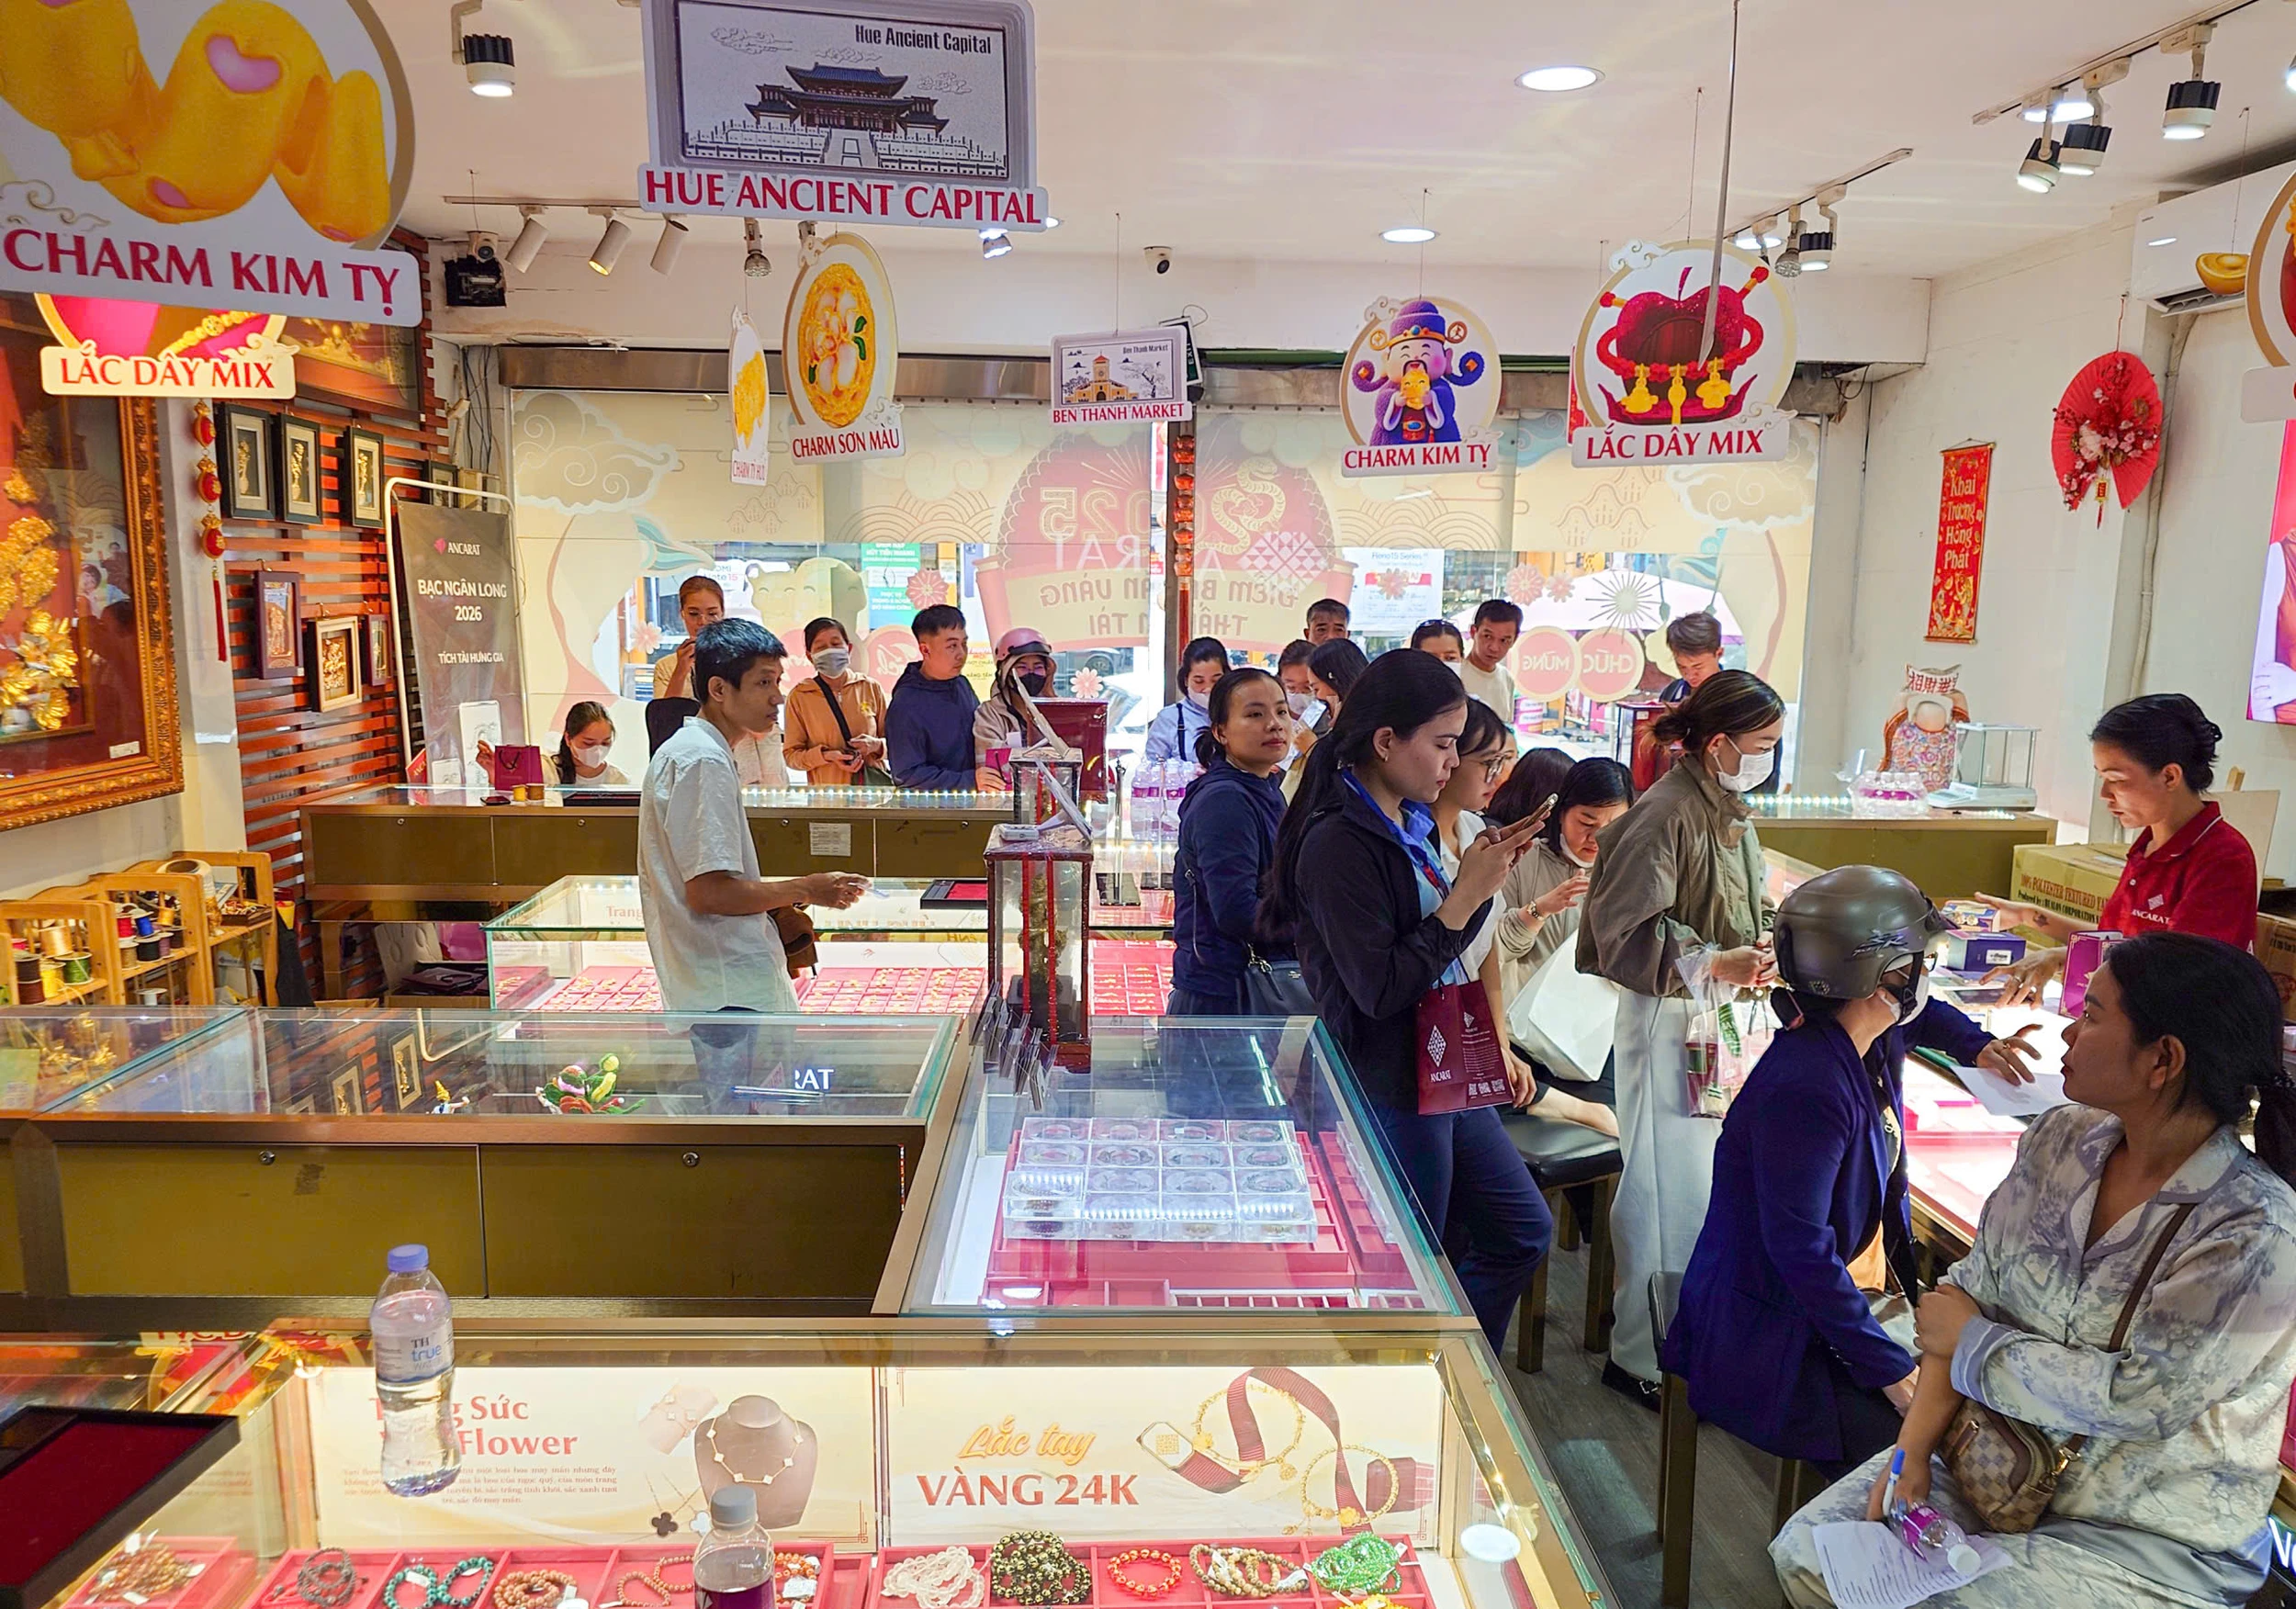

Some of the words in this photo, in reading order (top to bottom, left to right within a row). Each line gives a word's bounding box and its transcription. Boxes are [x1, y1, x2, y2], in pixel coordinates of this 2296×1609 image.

[855, 24, 882, 44] Hue
[885, 28, 940, 50] Ancient
[943, 32, 992, 55] Capital
[645, 169, 726, 208] HUE
[735, 174, 895, 217] ANCIENT
[905, 185, 1042, 225] CAPITAL
[3, 228, 213, 288] CHARM
[231, 251, 330, 298] KIM
[342, 262, 400, 317] TỴ
[1122, 346, 1133, 354] Ben
[1133, 344, 1148, 354] Thanh
[1148, 344, 1169, 353] Market
[61, 349, 123, 387] LẮC
[134, 353, 200, 388] DÂY
[212, 359, 276, 389] MIX
[1052, 410, 1077, 423] BEN
[1081, 407, 1128, 422] THANH
[1131, 403, 1184, 420] MARKET
[793, 435, 837, 458] CHARM
[838, 431, 867, 454] SƠN
[869, 421, 900, 451] MÀU
[1586, 422, 1637, 461] LẮC
[1643, 427, 1702, 459] DÂY
[1705, 428, 1763, 456] MIX
[1344, 446, 1415, 469] CHARM
[1422, 444, 1461, 466] KIM
[1467, 443, 1491, 469] TỴ
[1950, 473, 1976, 498] Khai
[447, 543, 481, 556] ANCARAT
[1943, 547, 1970, 570] Phát
[417, 579, 444, 600] BẠC
[444, 578, 478, 597] NGÂN
[478, 582, 508, 598] LONG
[455, 605, 483, 622] 2026
[438, 650, 457, 665] TÍCH
[457, 650, 469, 664] TÀI
[493, 652, 504, 663] GIA
[2131, 908, 2171, 926] ANCARAT
[1430, 1069, 1452, 1083] ANCARAT
[410, 1345, 443, 1362] true
[411, 1336, 430, 1349] TH
[470, 1394, 530, 1421] Sức
[458, 1427, 579, 1456] Flower
[957, 1414, 1030, 1459] Lắc
[1036, 1422, 1097, 1466] tay
[917, 1466, 1043, 1506] VÀNG
[1054, 1474, 1140, 1506] 24K
